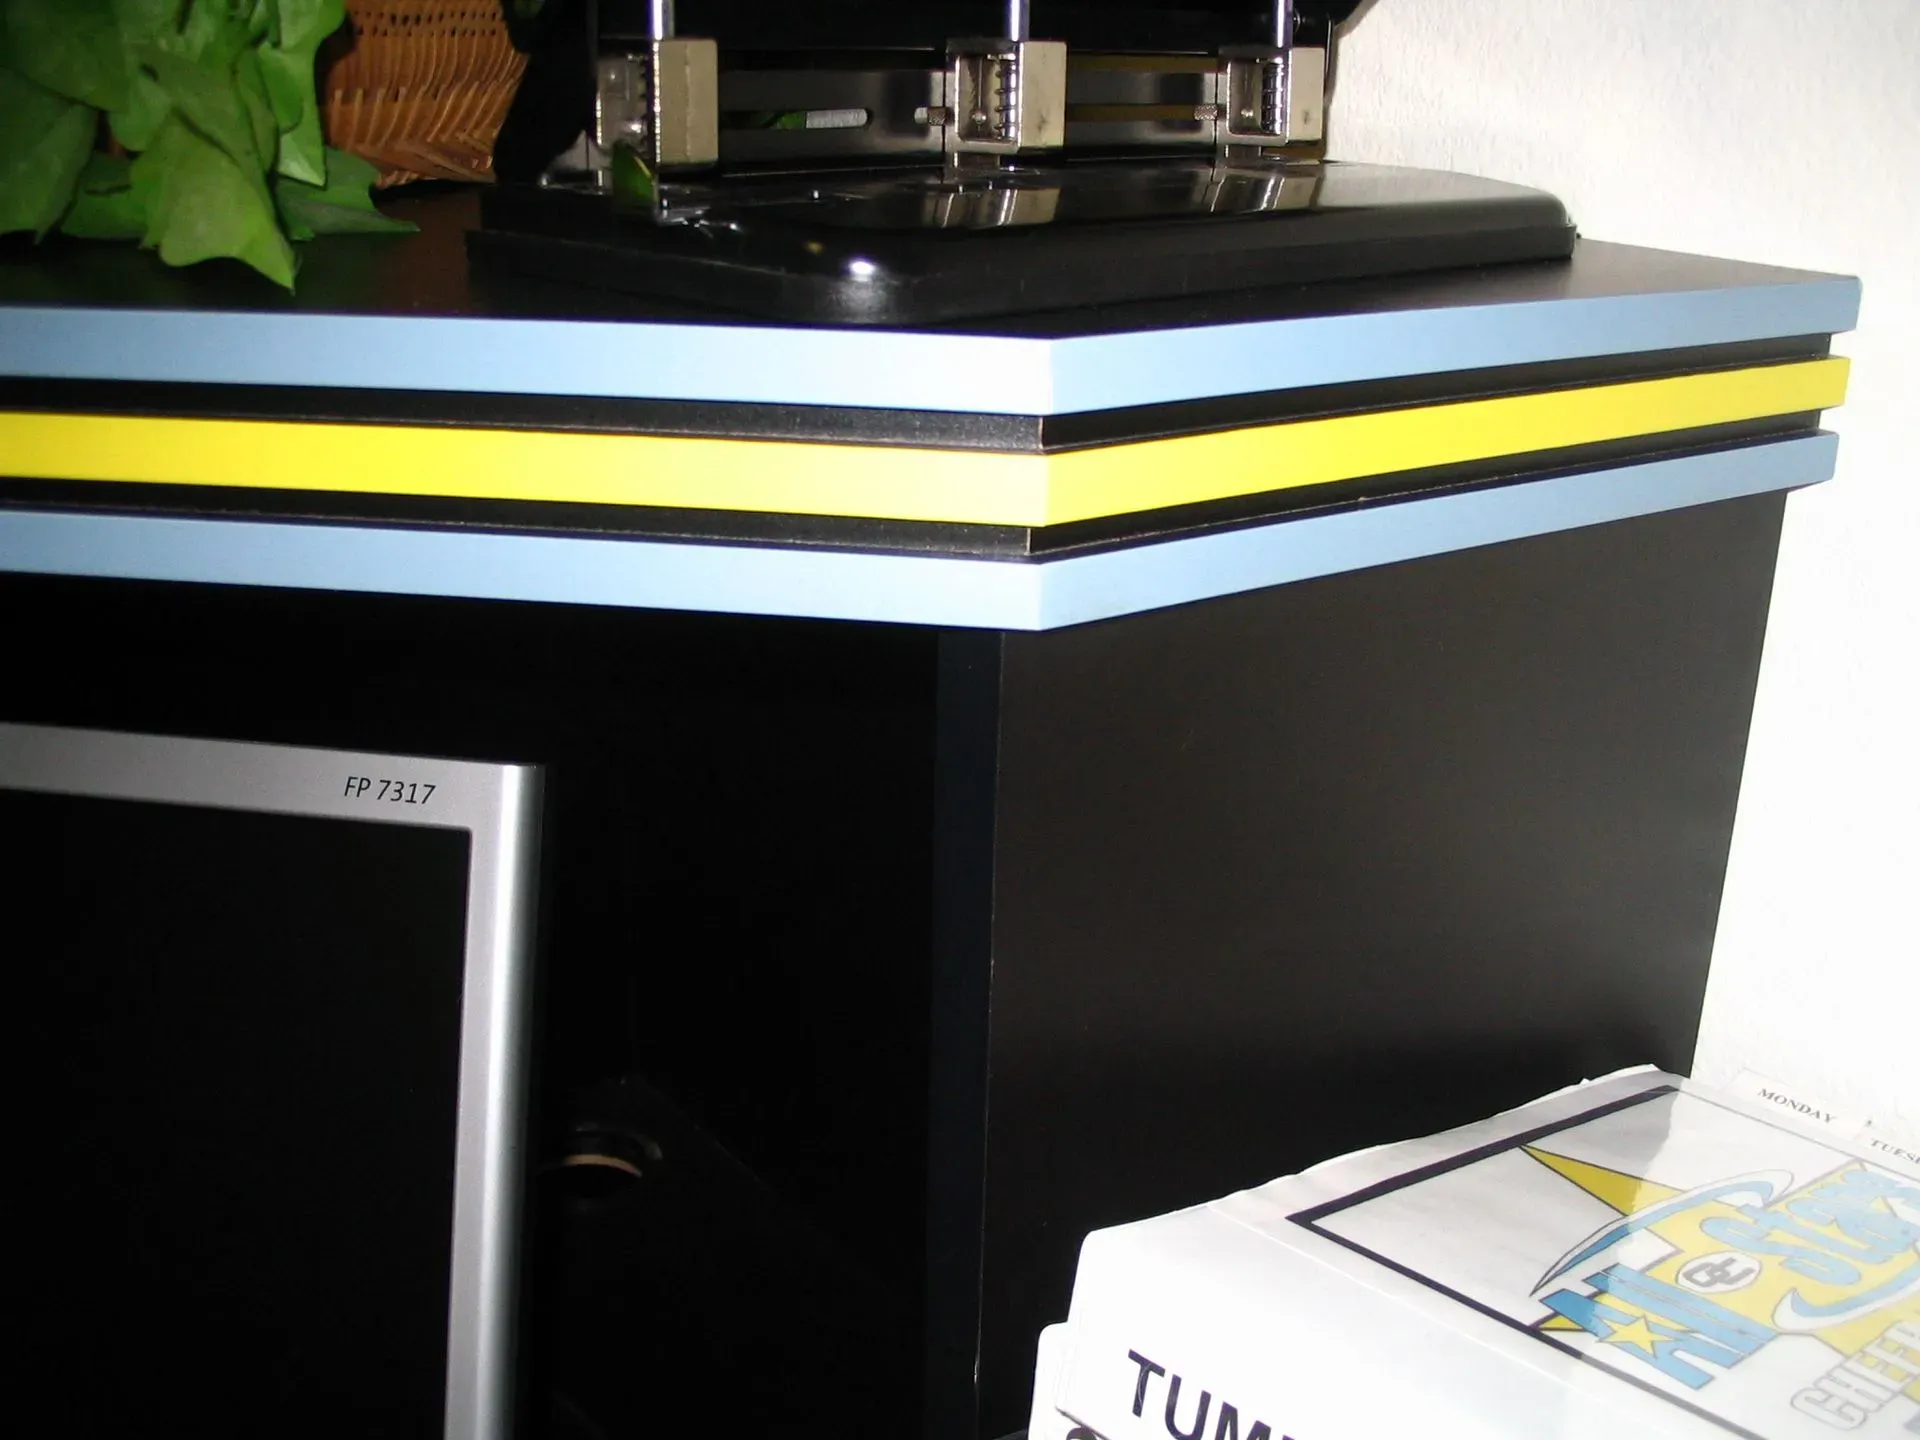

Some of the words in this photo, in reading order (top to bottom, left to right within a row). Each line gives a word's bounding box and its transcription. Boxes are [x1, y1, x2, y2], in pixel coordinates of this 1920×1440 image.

[344, 776, 371, 797] FP
[377, 779, 436, 805] 7317
[1757, 1088, 1837, 1124] MONDAY
